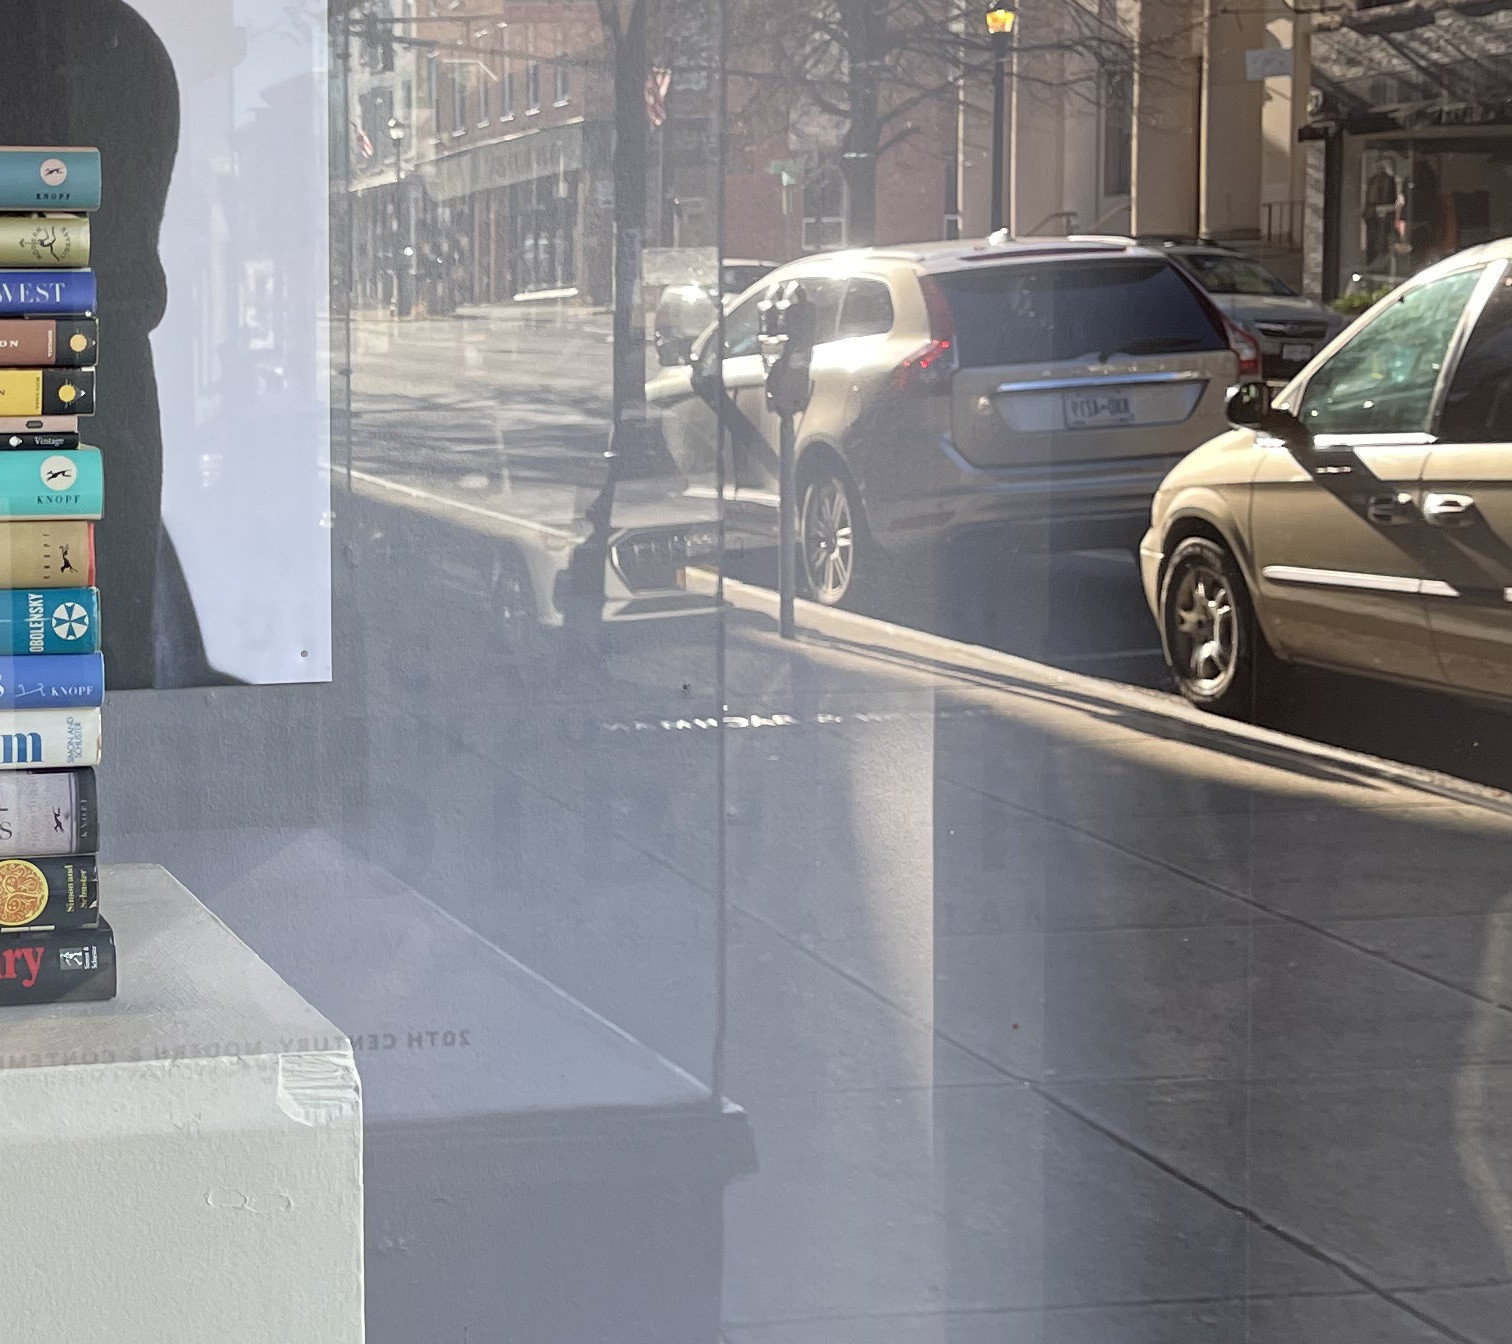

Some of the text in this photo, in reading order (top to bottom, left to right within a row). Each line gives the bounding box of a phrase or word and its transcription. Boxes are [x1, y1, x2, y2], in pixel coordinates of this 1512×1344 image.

[34, 436, 65, 447] Vintage
[37, 494, 81, 504] KNOPF
[28, 593, 45, 653] OBOLENSKY
[51, 685, 94, 697] KNOPF
